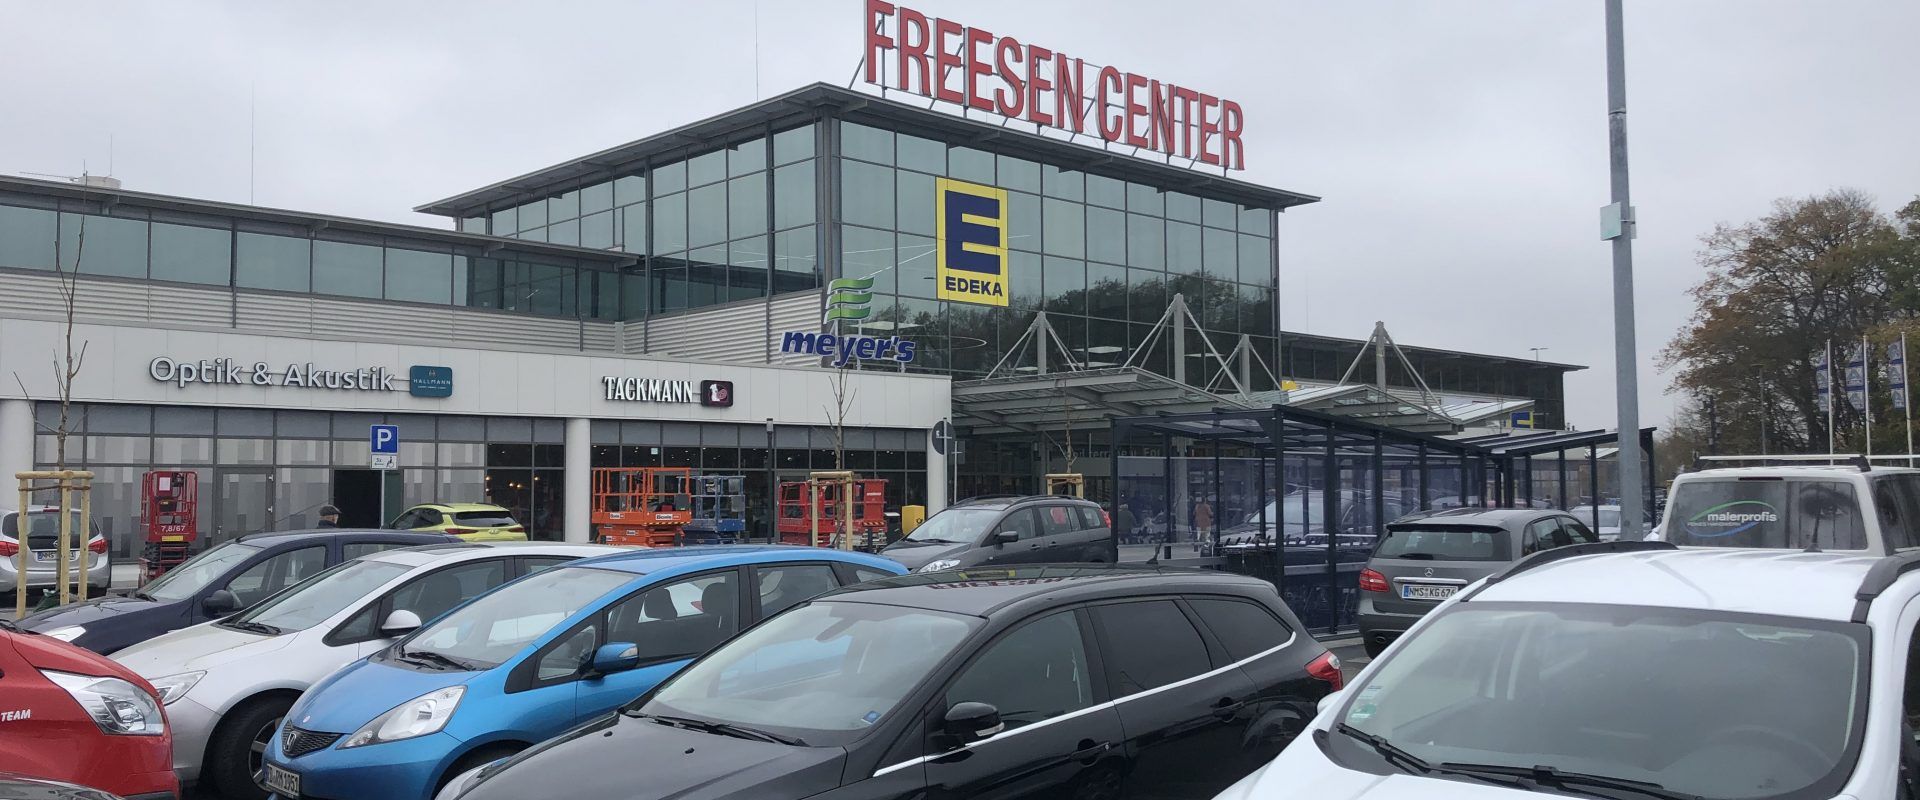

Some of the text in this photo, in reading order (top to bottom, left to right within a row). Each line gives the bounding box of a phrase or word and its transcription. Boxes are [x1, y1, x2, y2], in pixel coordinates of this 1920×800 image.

[865, 0, 1245, 170] FREESEN CENTER
[945, 275, 1003, 297] EDEKA
[780, 331, 916, 367] meyer's
[150, 356, 395, 391] Optik & Akustik
[602, 376, 693, 403] TACKMANN
[377, 429, 392, 449] P
[1707, 511, 1777, 523] malerprofis
[1409, 587, 1424, 597] NMS
[0, 709, 31, 722] TEAM
